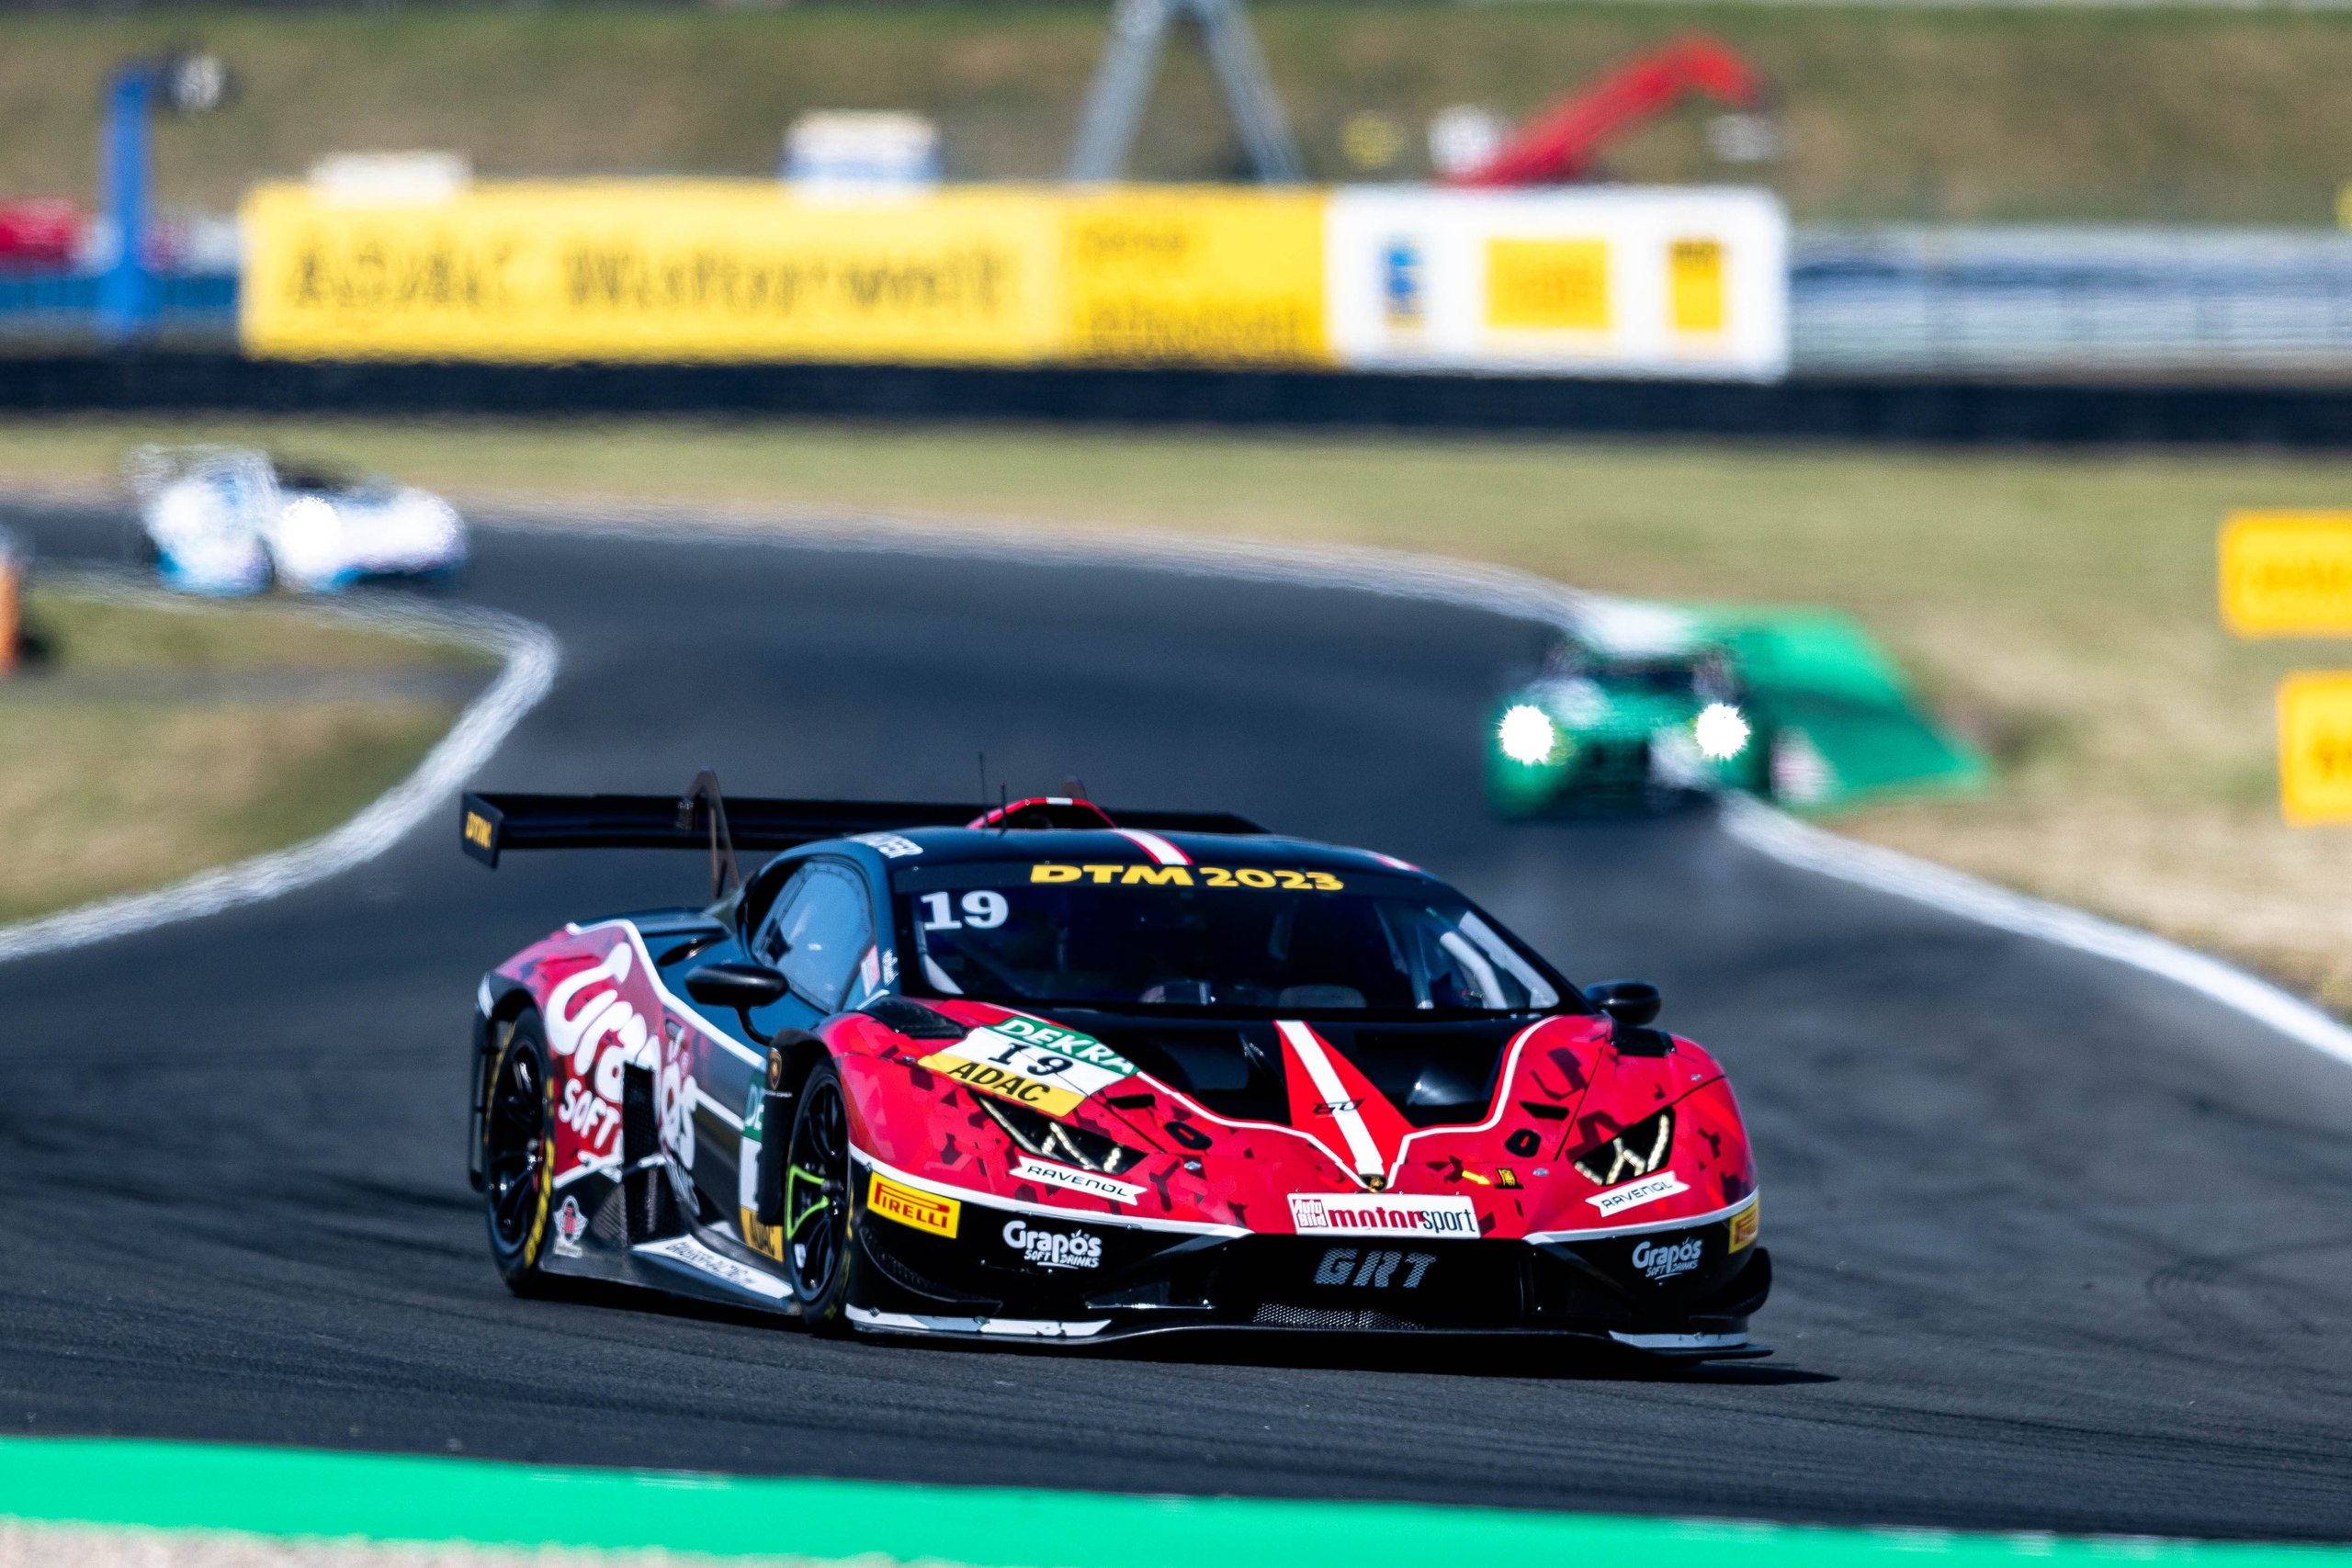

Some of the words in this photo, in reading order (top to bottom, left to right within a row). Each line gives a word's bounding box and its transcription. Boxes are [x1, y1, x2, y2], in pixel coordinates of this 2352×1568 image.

[465, 810, 492, 850] DTM
[1030, 864, 1193, 886] DTM
[1199, 867, 1344, 891] 2023
[922, 890, 1009, 931] 19
[988, 1043, 1074, 1077] 19
[994, 1019, 1137, 1074] DEKRA
[949, 1061, 1050, 1103] ADAC
[559, 1077, 621, 1150] SOFT
[1026, 1165, 1128, 1197] RAVENOL
[1601, 1180, 1673, 1208] RAVENOL
[875, 1180, 951, 1229] PIRELLI
[1023, 1248, 1050, 1262] SOFT
[1060, 1254, 1100, 1269] DRINKS
[1312, 1247, 1438, 1288] GRT
[1645, 1265, 1666, 1278] SOFT
[1671, 1259, 1699, 1273] DRINKS
